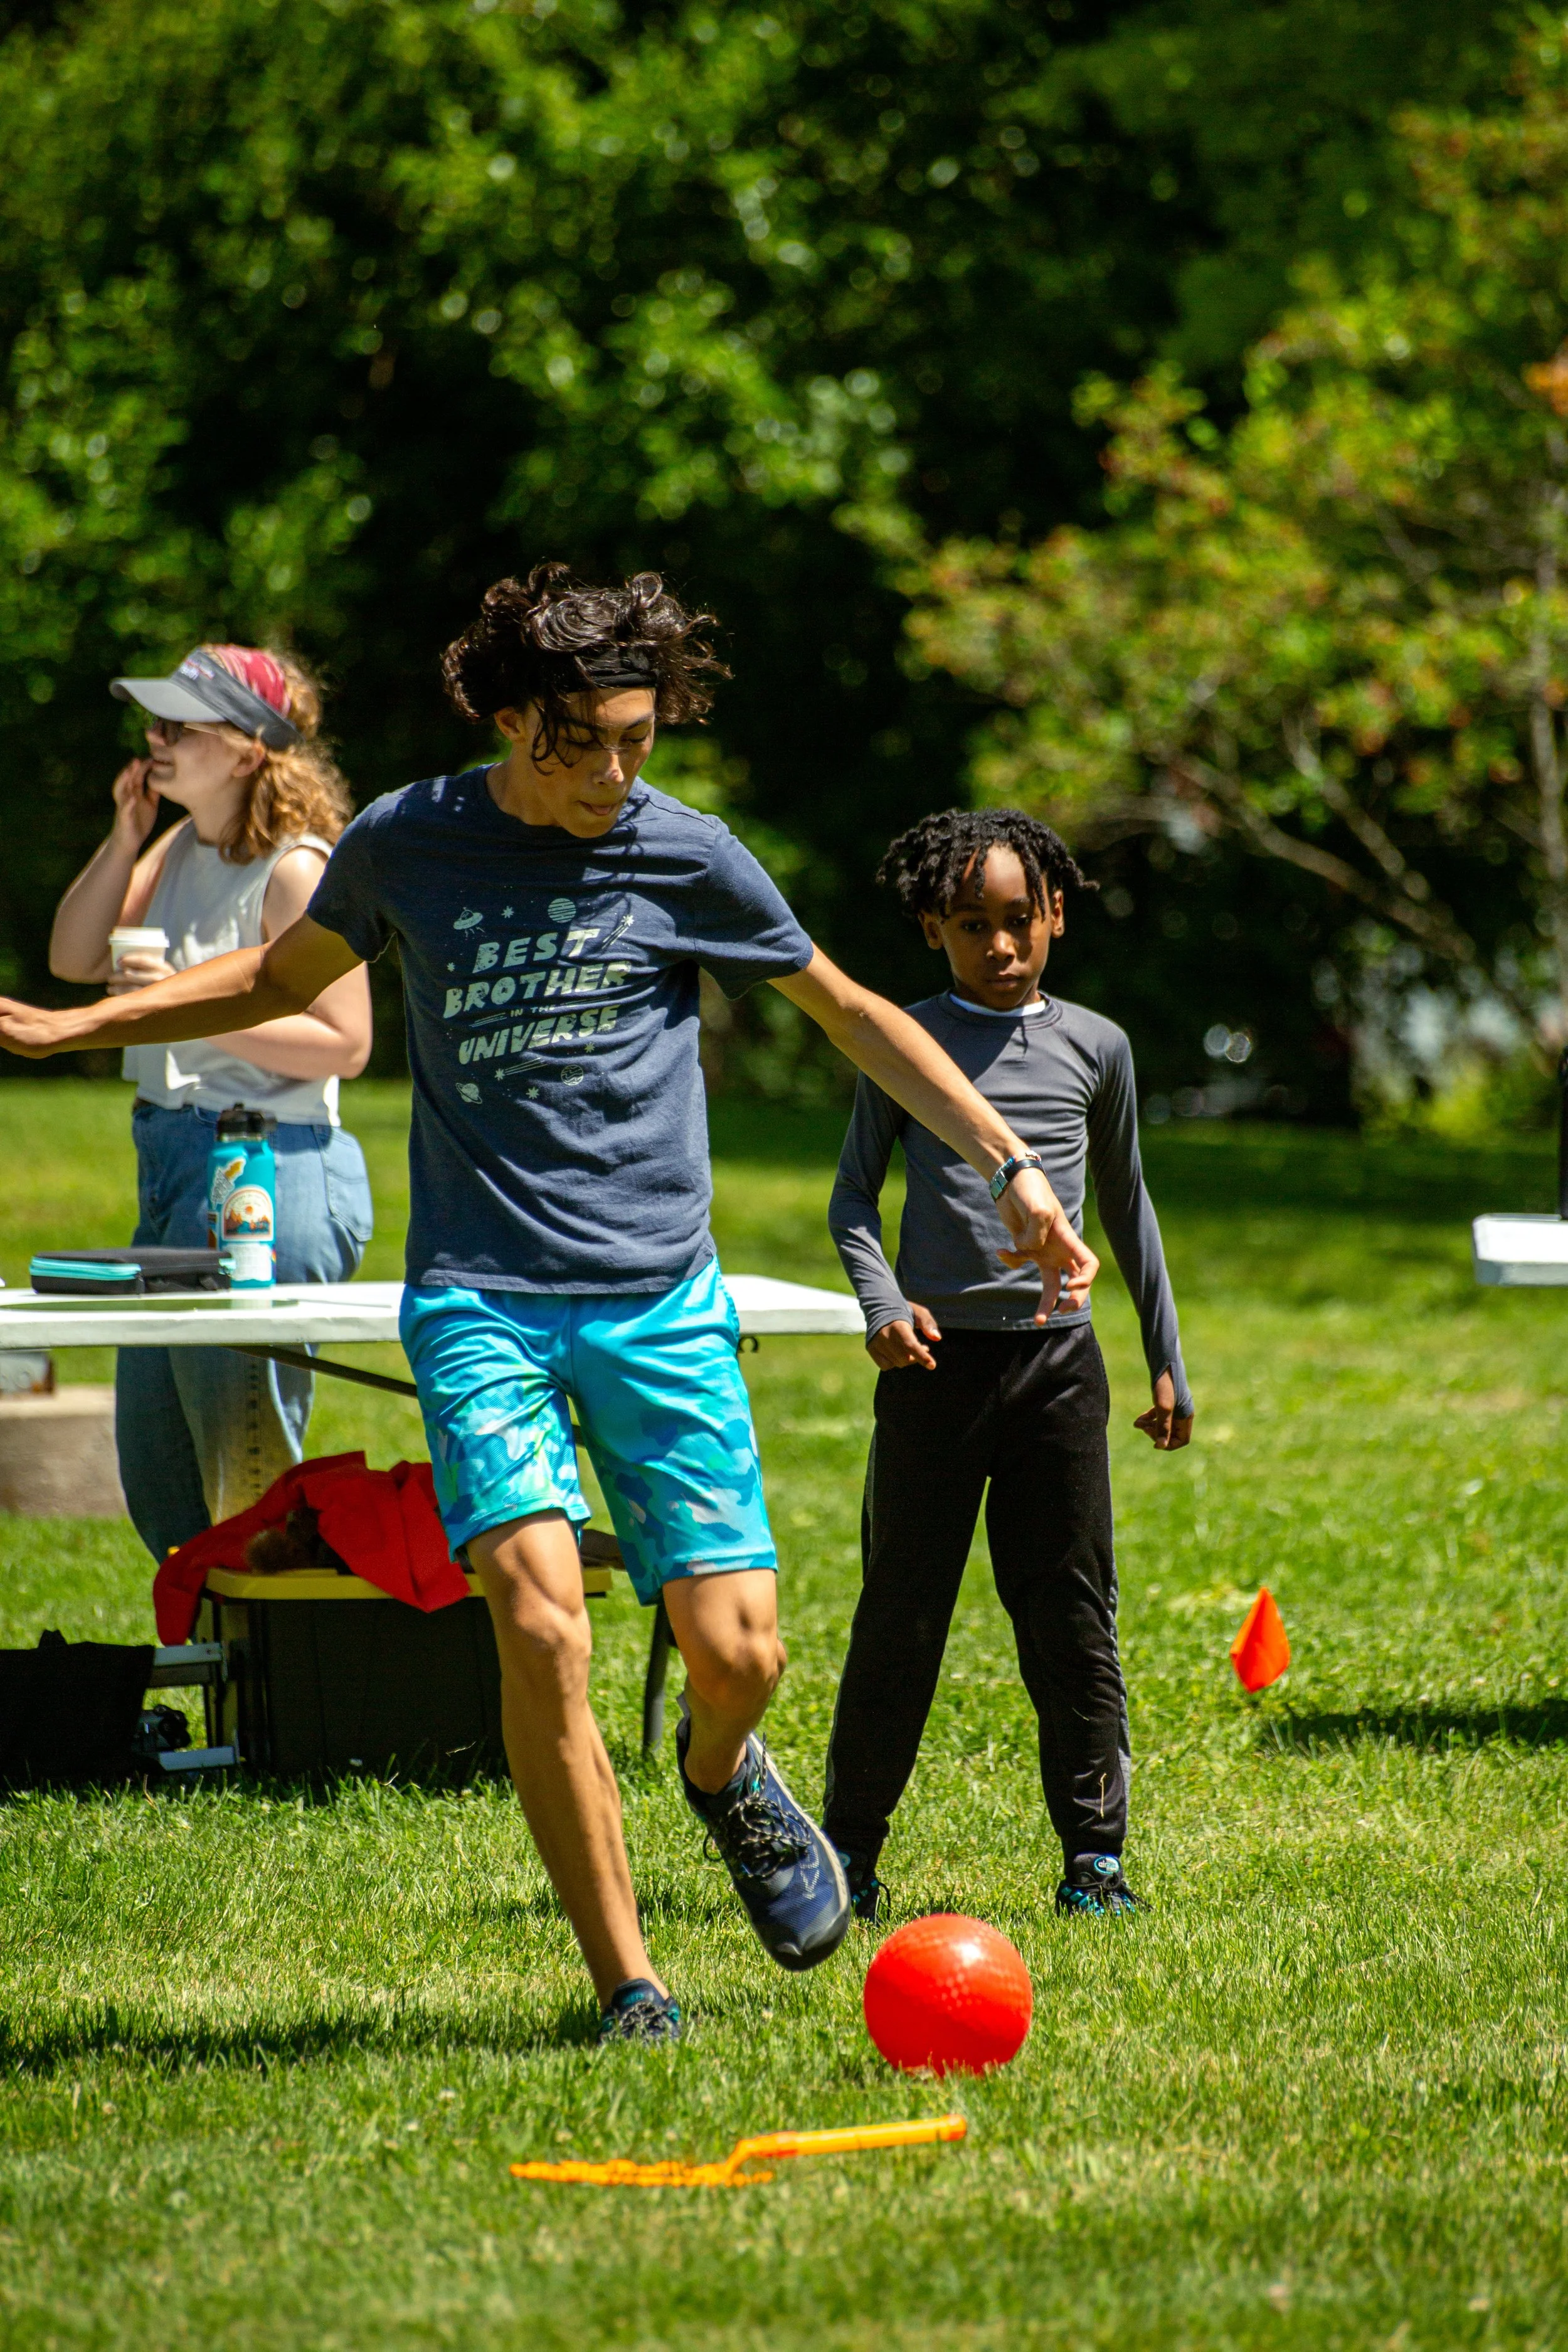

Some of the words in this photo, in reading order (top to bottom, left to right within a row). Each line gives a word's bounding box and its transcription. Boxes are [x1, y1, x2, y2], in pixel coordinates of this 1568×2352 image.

[473, 928, 600, 973] BEST
[443, 961, 632, 1018] BROTHER
[511, 1009, 523, 1017] IN
[459, 1005, 620, 1065] UNIVERSE
